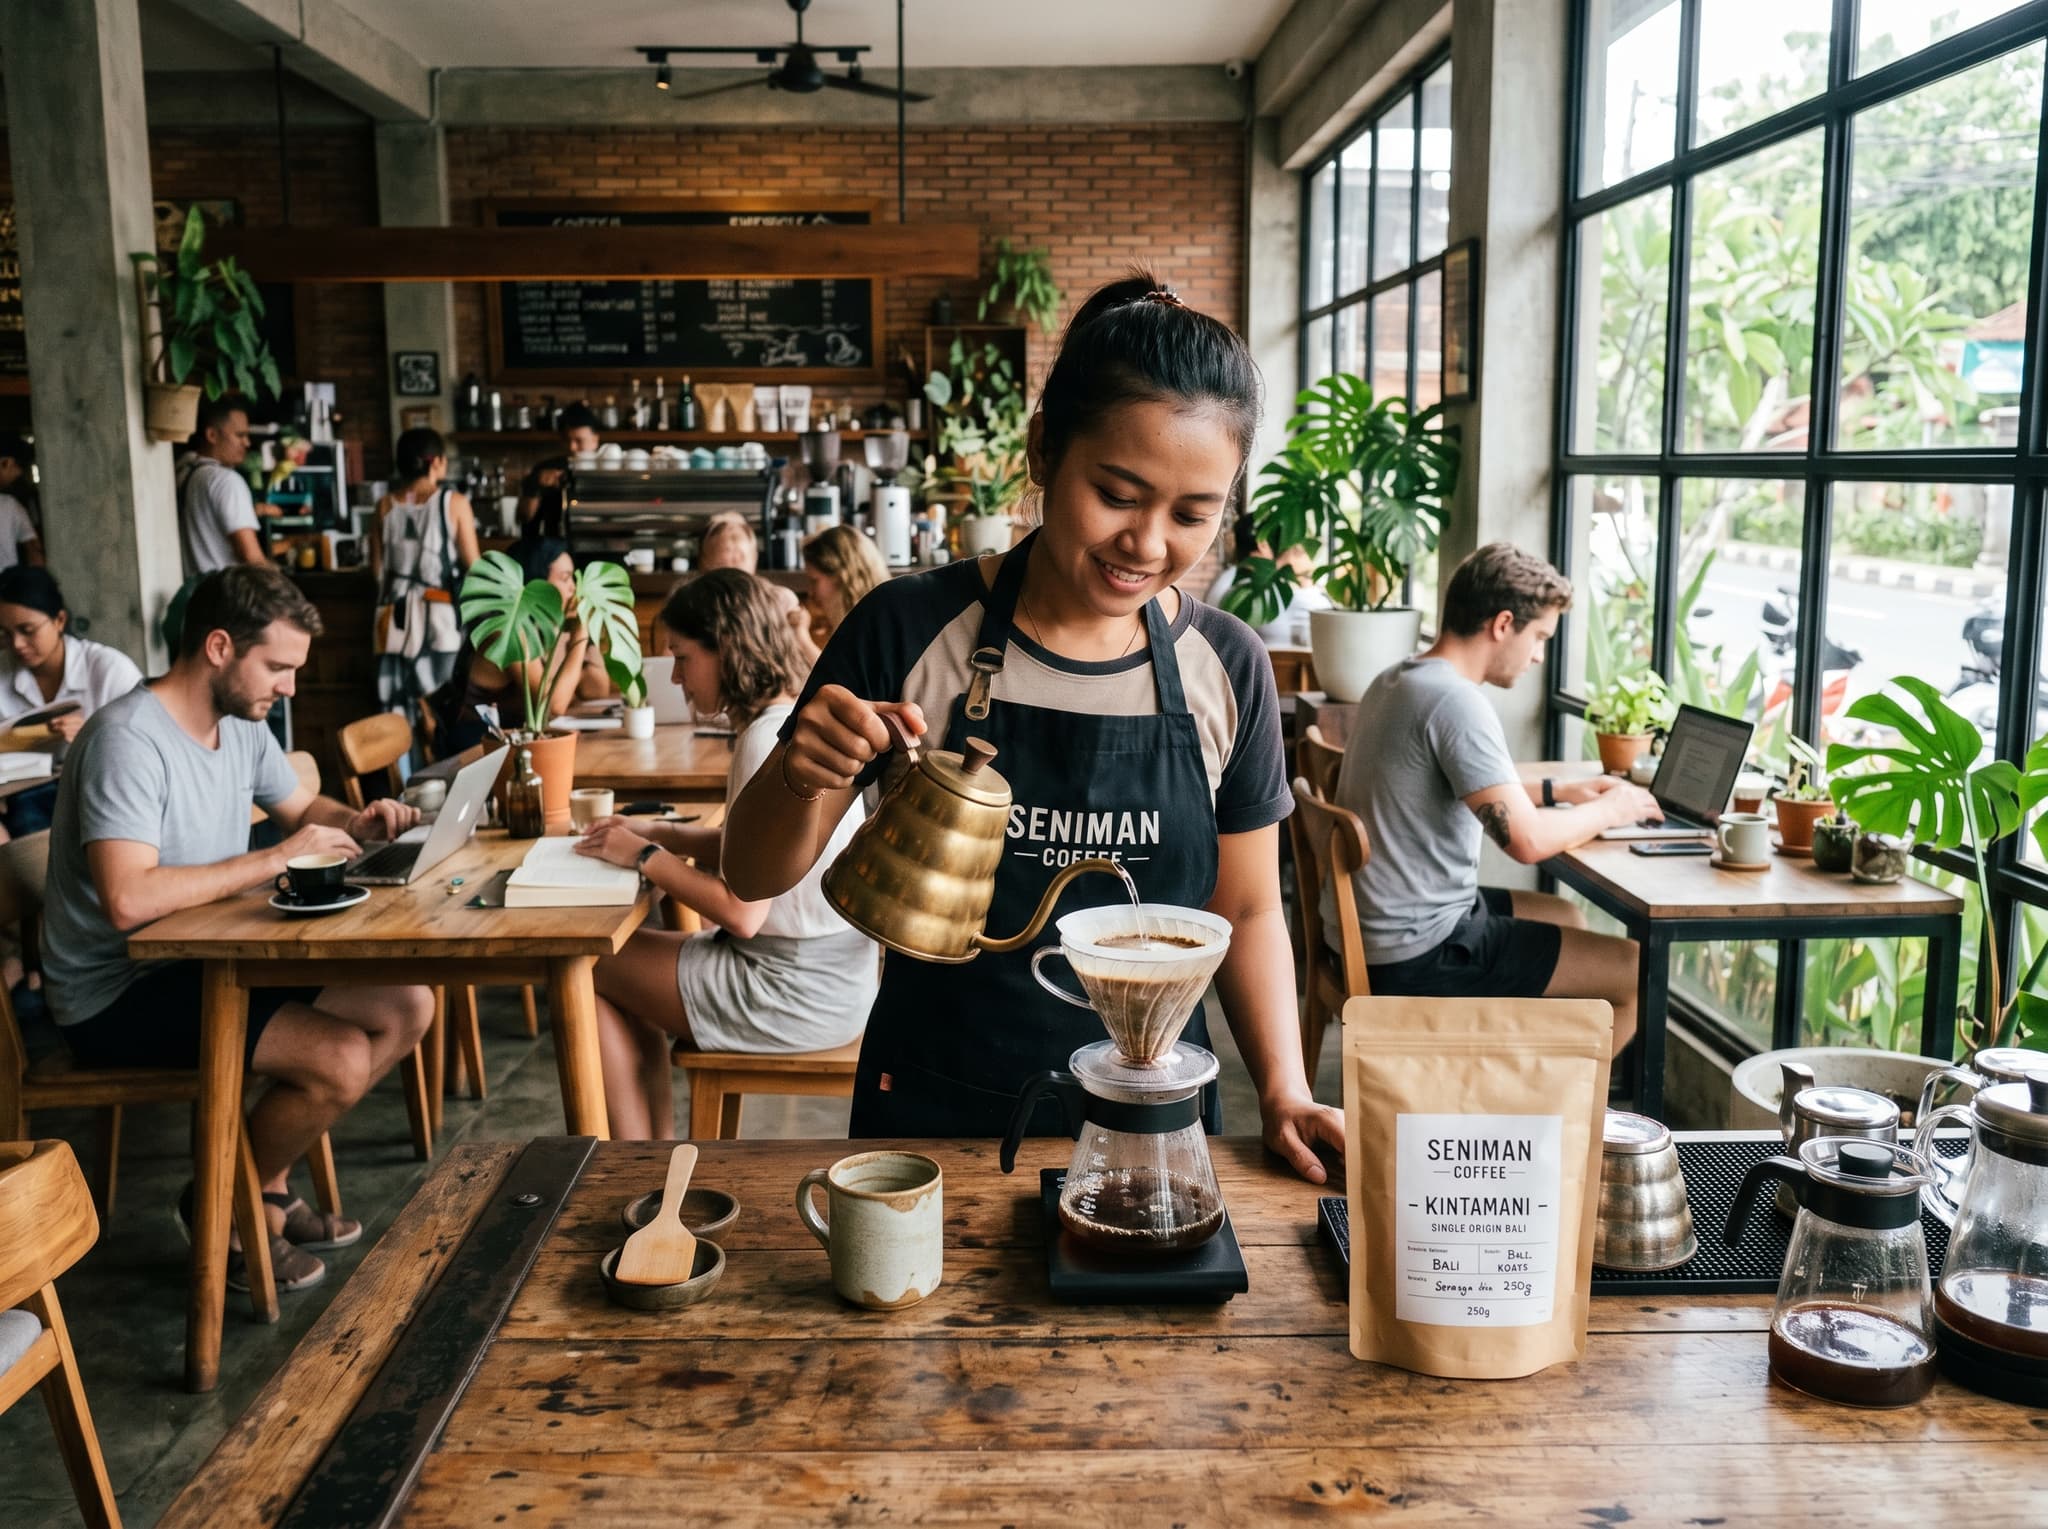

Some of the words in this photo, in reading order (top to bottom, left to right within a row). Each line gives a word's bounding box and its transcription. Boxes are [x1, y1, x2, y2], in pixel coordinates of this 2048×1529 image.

[1006, 803, 1160, 846] SENIMAN
[1427, 1138, 1532, 1162] SENIMAN
[1453, 1165, 1507, 1179] COFFEE
[1426, 1196, 1530, 1216] KINTAMANI
[1431, 1222, 1465, 1233] SINGLE
[1468, 1223, 1502, 1233] ORIGIN
[1505, 1223, 1527, 1233] BALI
[1432, 1258, 1460, 1272] BALI
[1503, 1280, 1533, 1297] 250g
[1466, 1306, 1490, 1319] 250g
